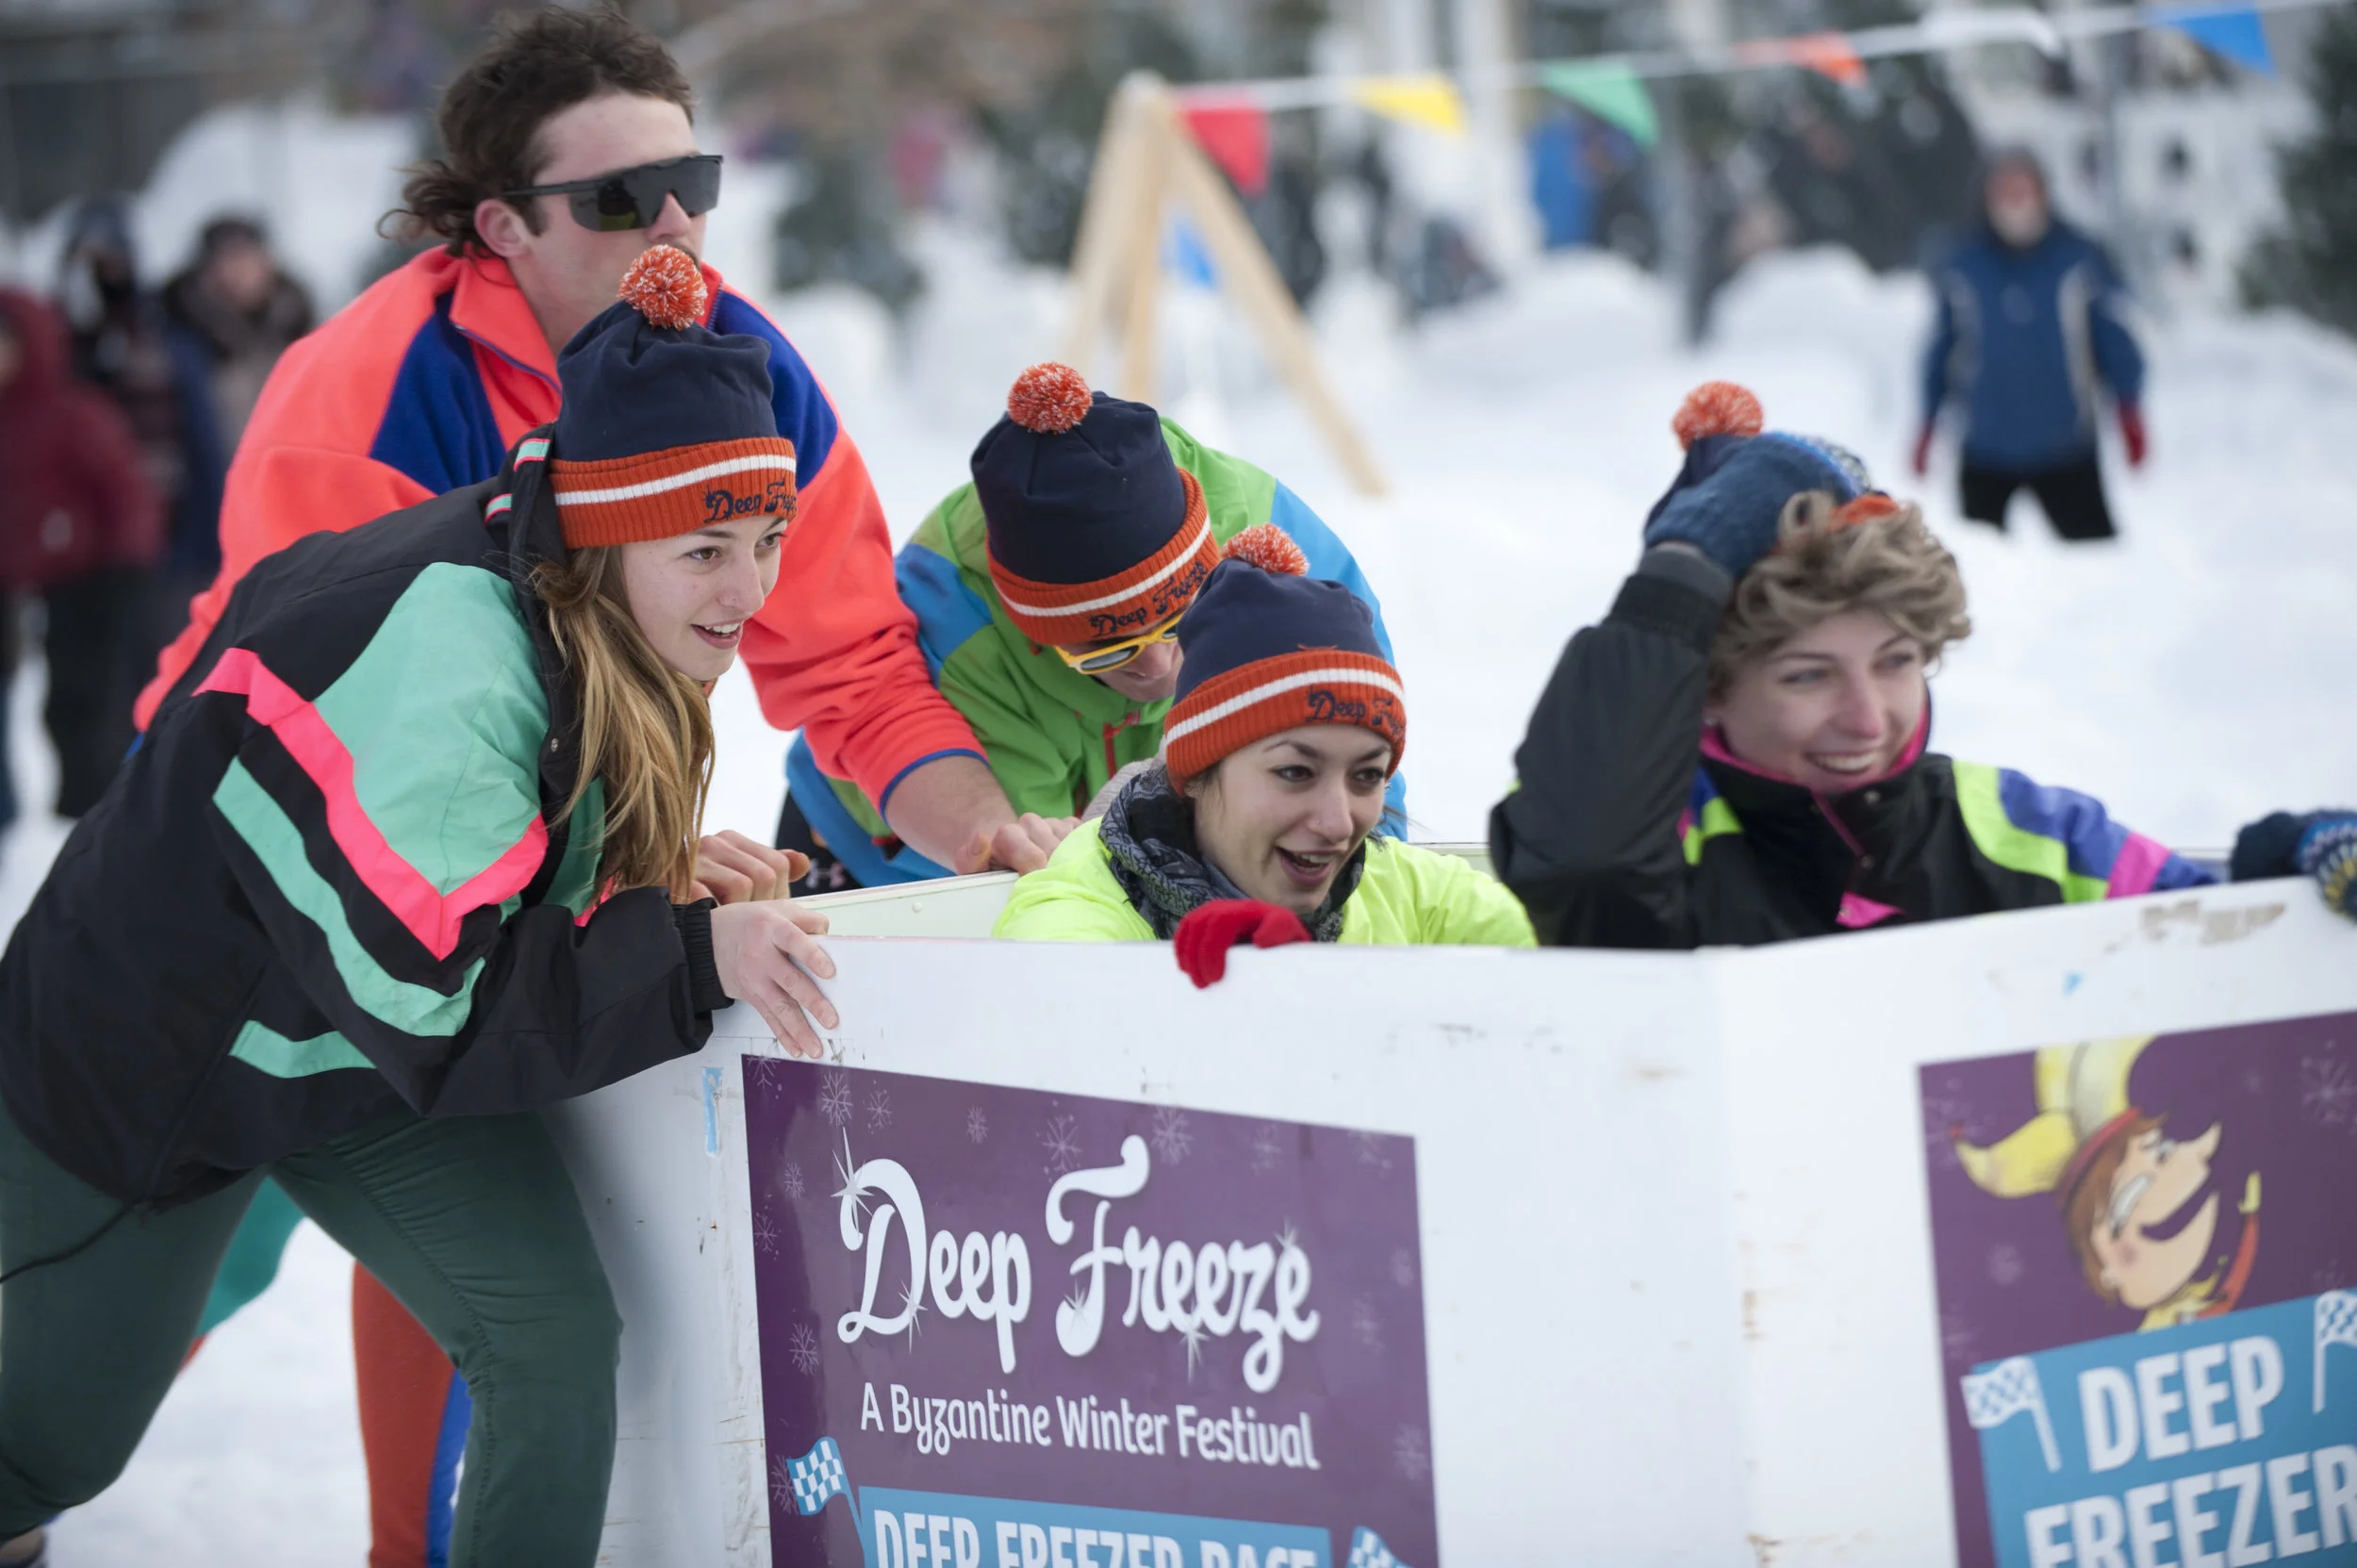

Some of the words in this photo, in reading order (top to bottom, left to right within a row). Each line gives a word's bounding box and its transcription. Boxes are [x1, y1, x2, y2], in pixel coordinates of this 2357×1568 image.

[703, 487, 762, 523] Deep
[1089, 606, 1147, 637] Deep
[1304, 687, 1366, 724] Deep
[837, 1158, 1031, 1374] Deep
[1046, 1134, 1320, 1394] Freeze
[861, 1381, 884, 1432] A
[890, 1383, 1052, 1456] Byzantine
[1056, 1395, 1169, 1456] Winter
[1176, 1404, 1321, 1470] Festival
[2077, 1335, 2285, 1474] DEEP
[874, 1510, 981, 1568] DEEP
[2023, 1444, 2357, 1568] FREEZER
